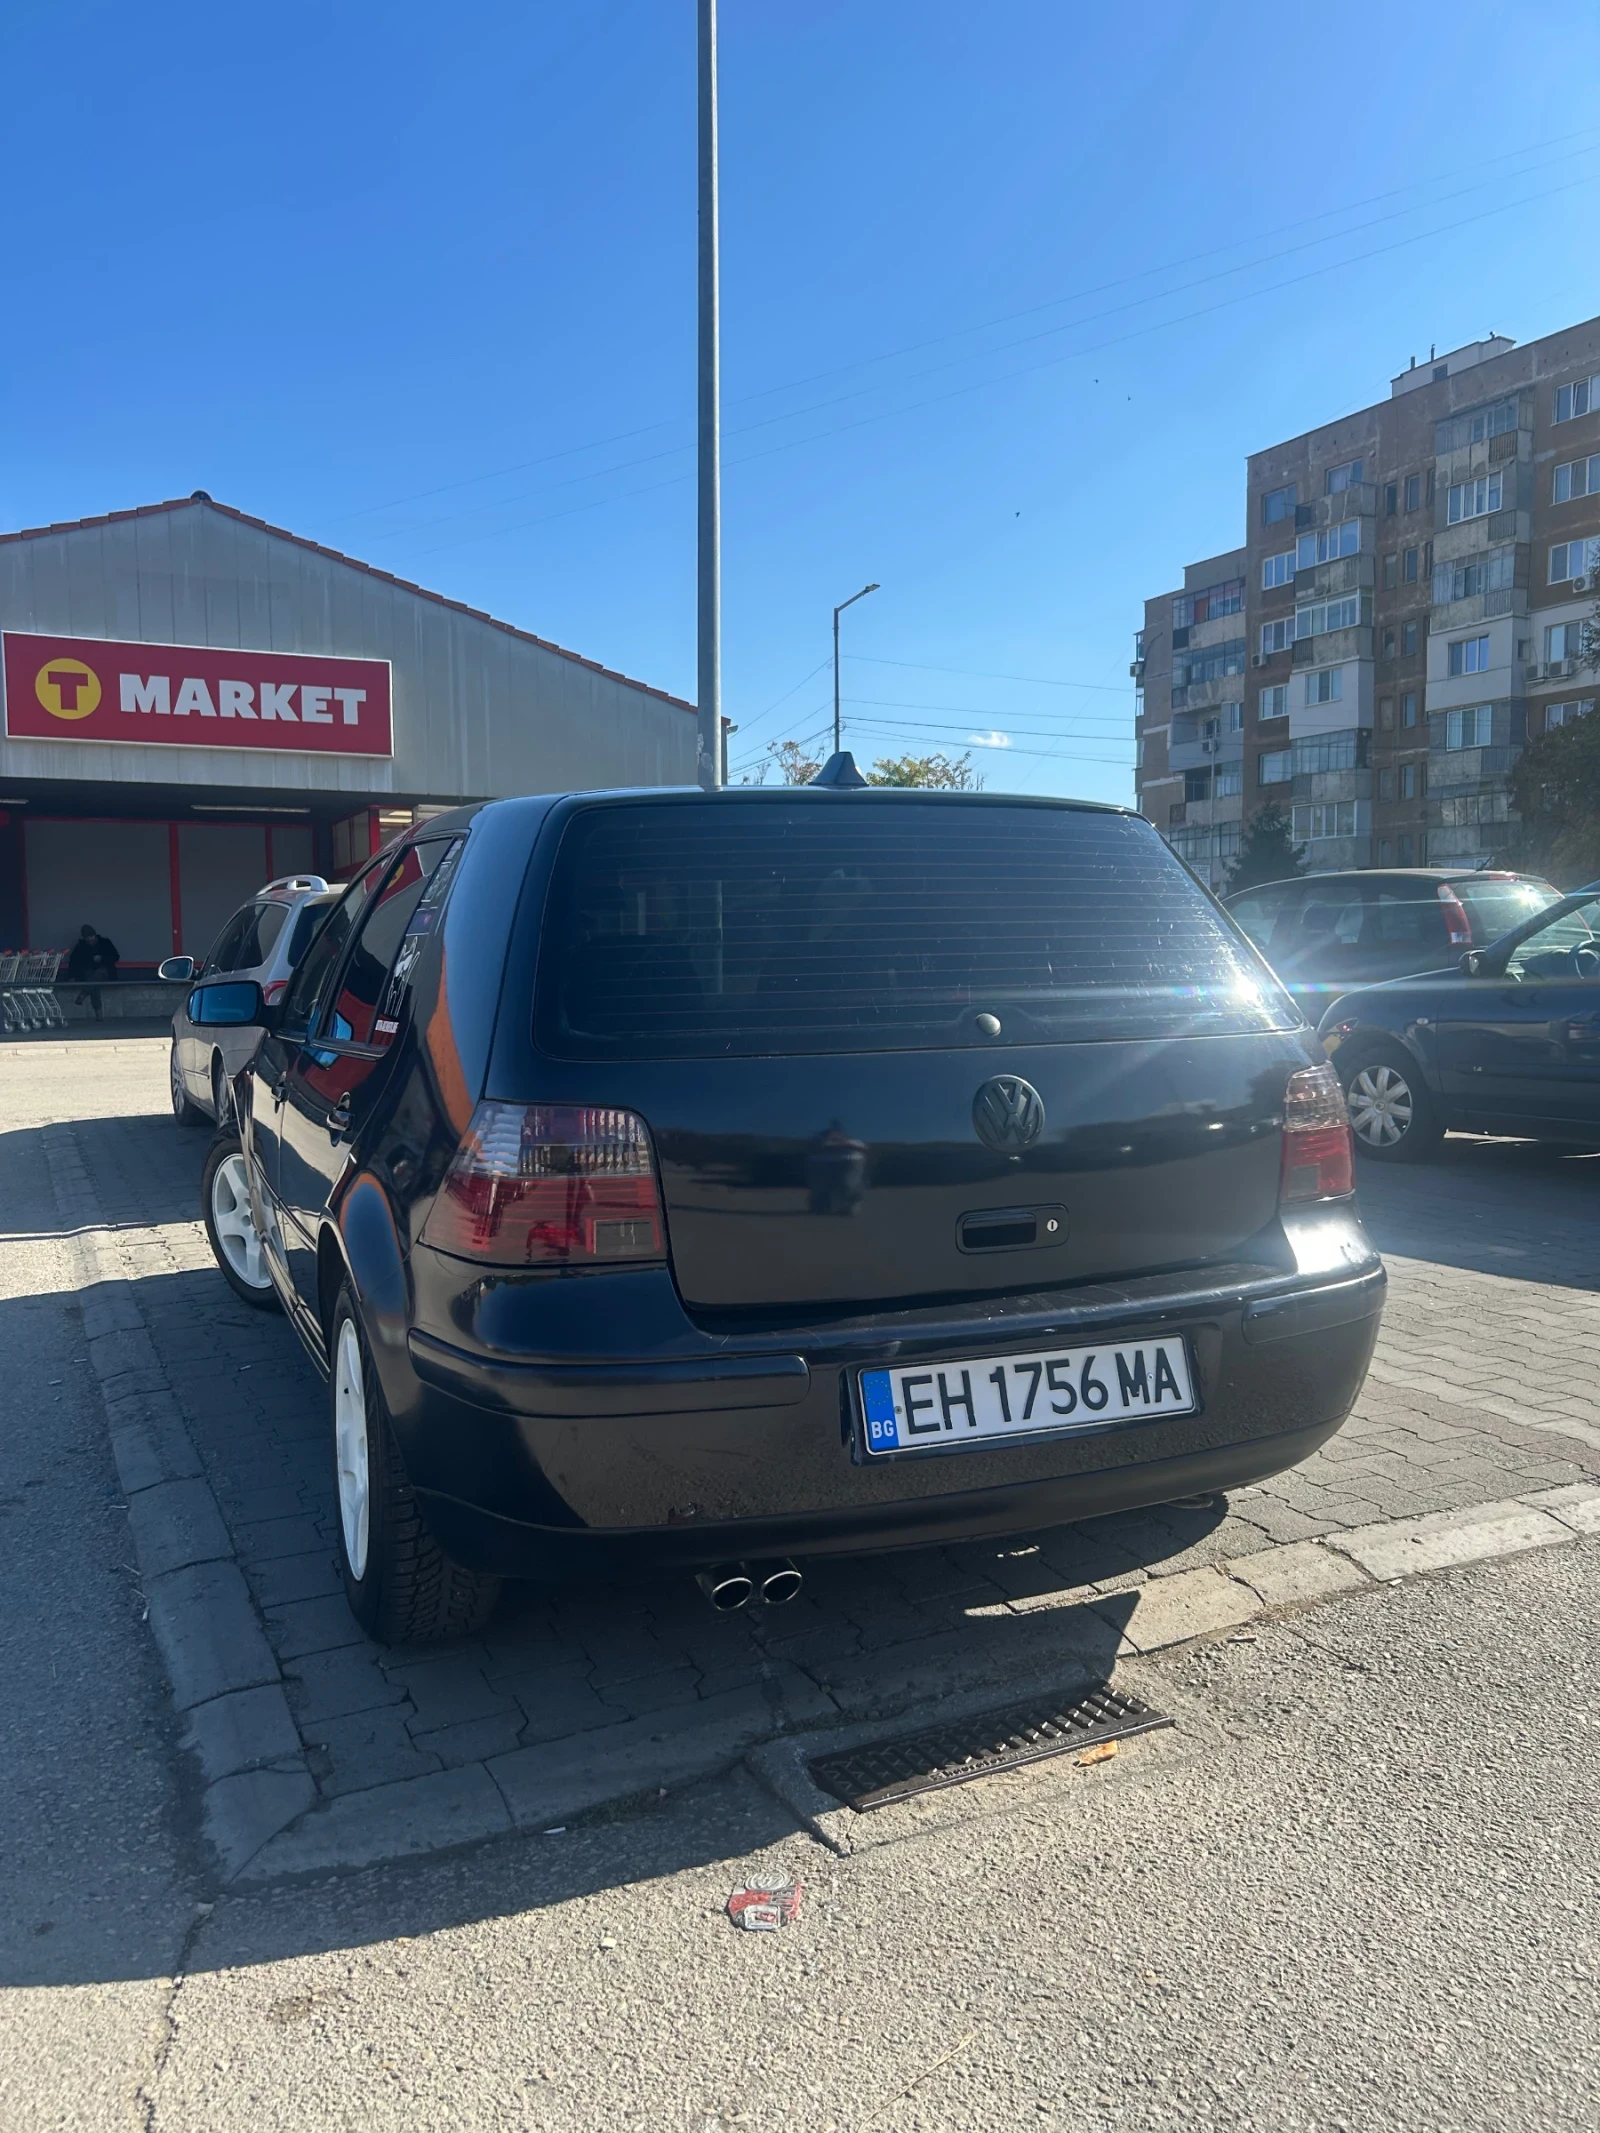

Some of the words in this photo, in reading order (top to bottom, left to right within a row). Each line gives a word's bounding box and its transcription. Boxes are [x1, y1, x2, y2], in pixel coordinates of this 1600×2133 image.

[48, 671, 88, 710] T
[119, 673, 367, 725] MARKET
[902, 1370, 976, 1435] EH
[989, 1355, 1109, 1422] 1756
[1115, 1348, 1182, 1407] MA
[871, 1419, 894, 1438] BG
